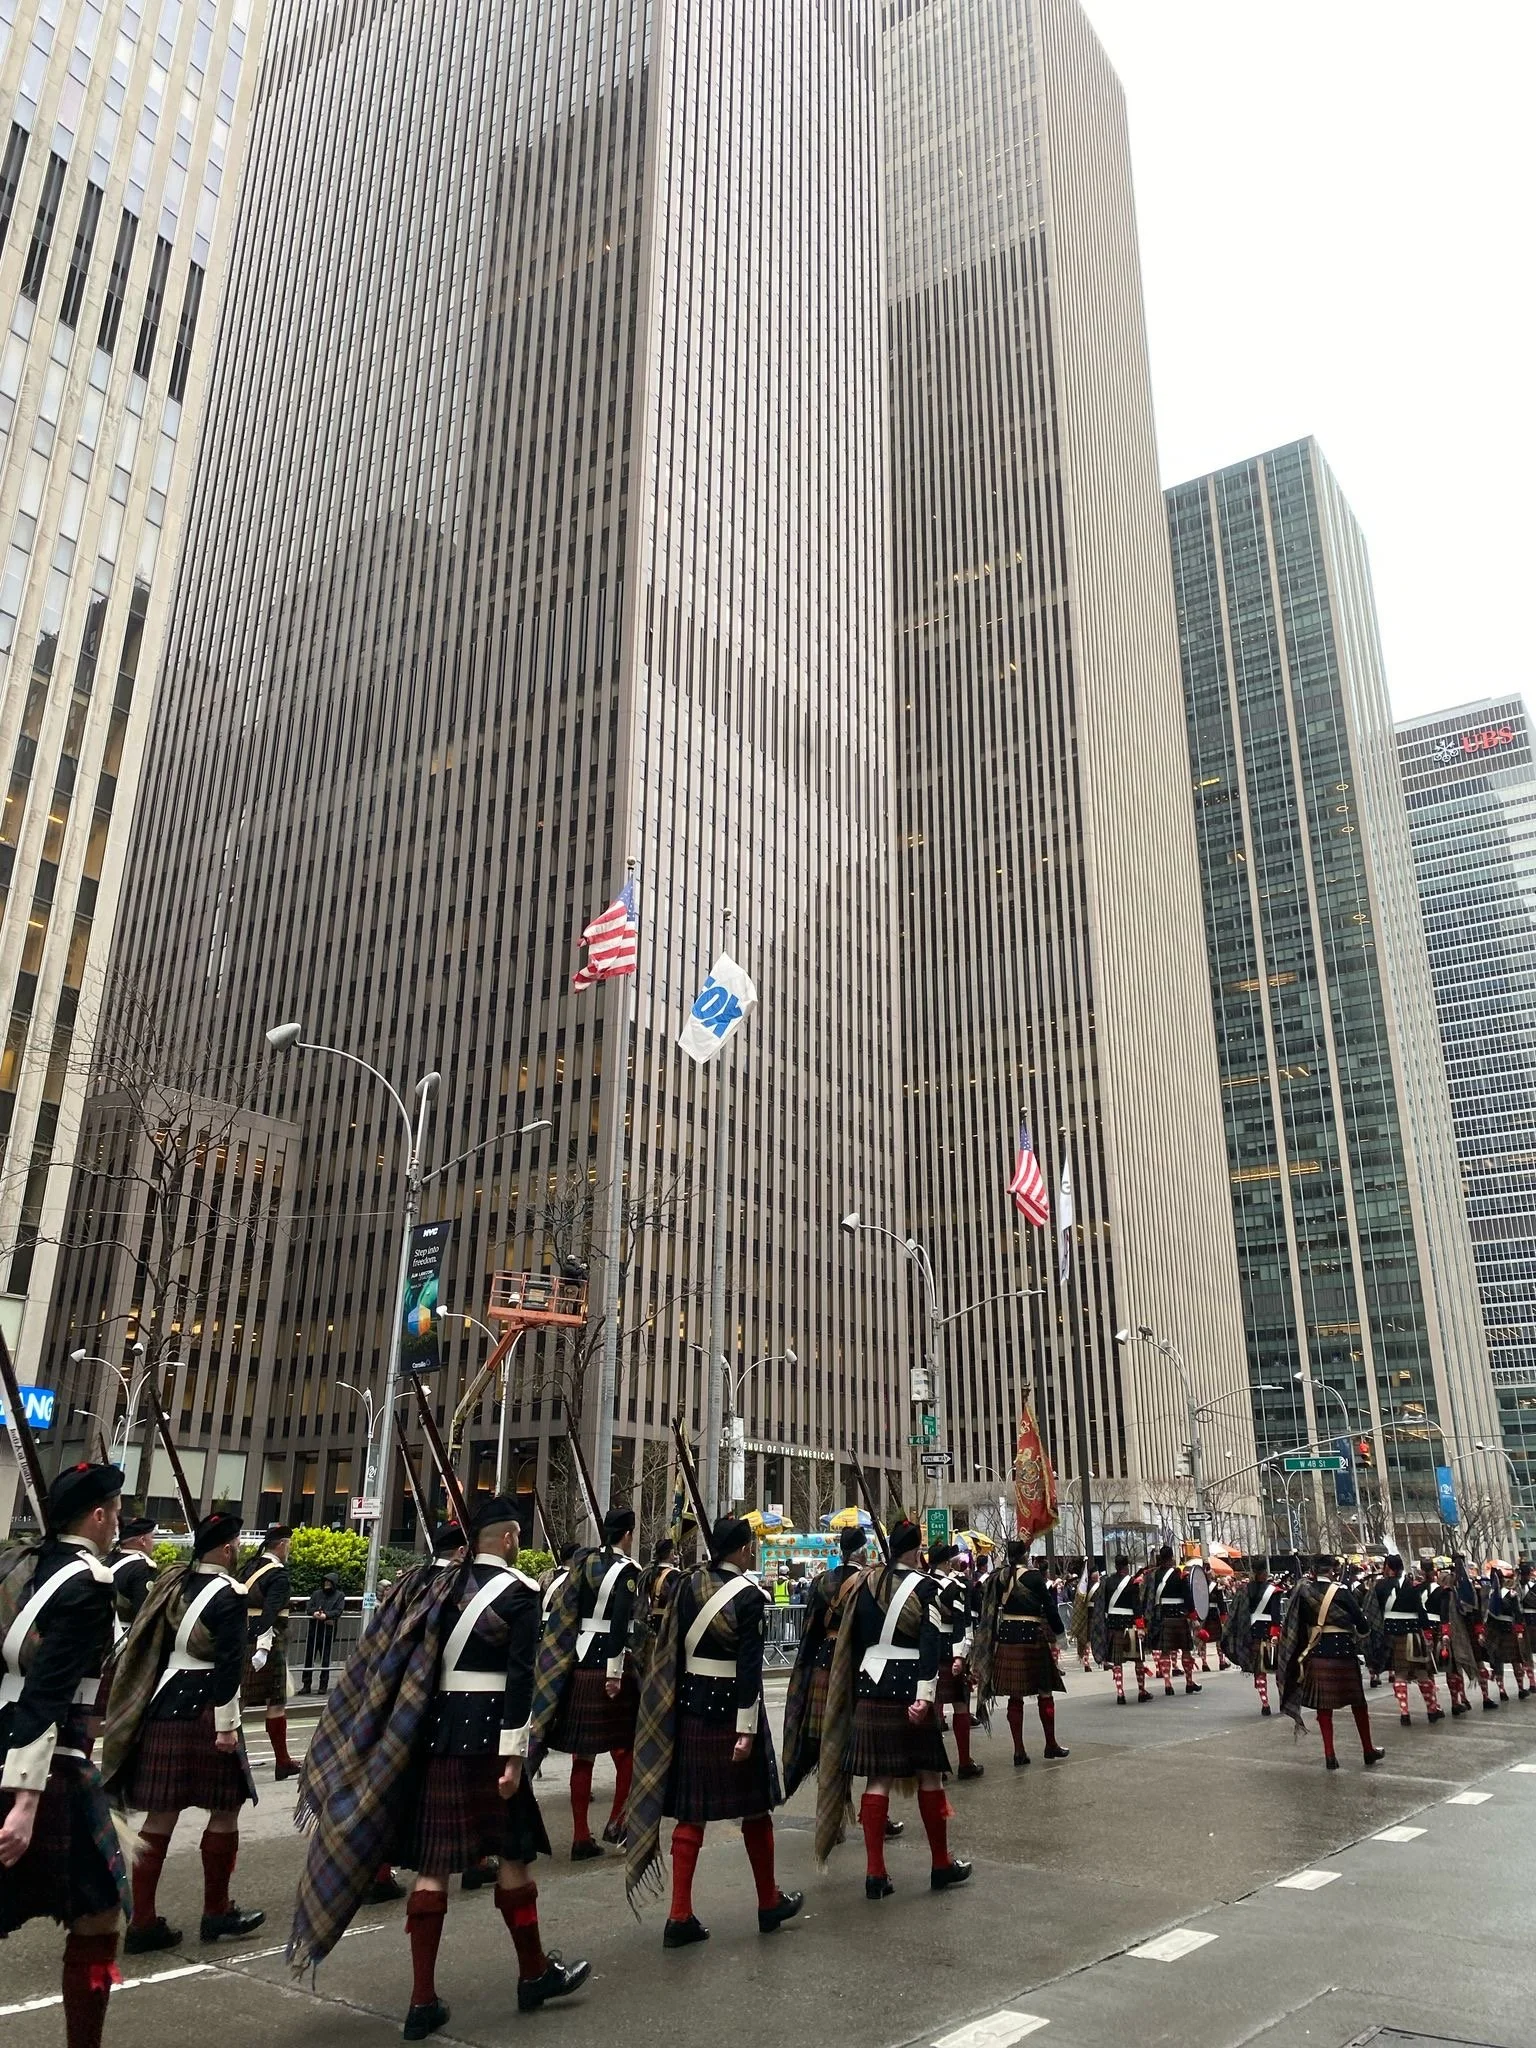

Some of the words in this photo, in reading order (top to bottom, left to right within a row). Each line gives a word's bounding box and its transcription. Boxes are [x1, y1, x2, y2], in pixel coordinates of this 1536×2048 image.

[1461, 726, 1514, 753] UBS
[423, 1227, 438, 1237] NYC
[414, 1249, 427, 1257] Step
[428, 1246, 440, 1255] into
[743, 1441, 763, 1453] ENUE
[767, 1445, 777, 1454] OF
[781, 1446, 795, 1456] THE
[798, 1449, 834, 1461] AMERICAS
[1300, 1460, 1305, 1468] W
[1307, 1460, 1317, 1468] 48
[1318, 1460, 1326, 1468] St
